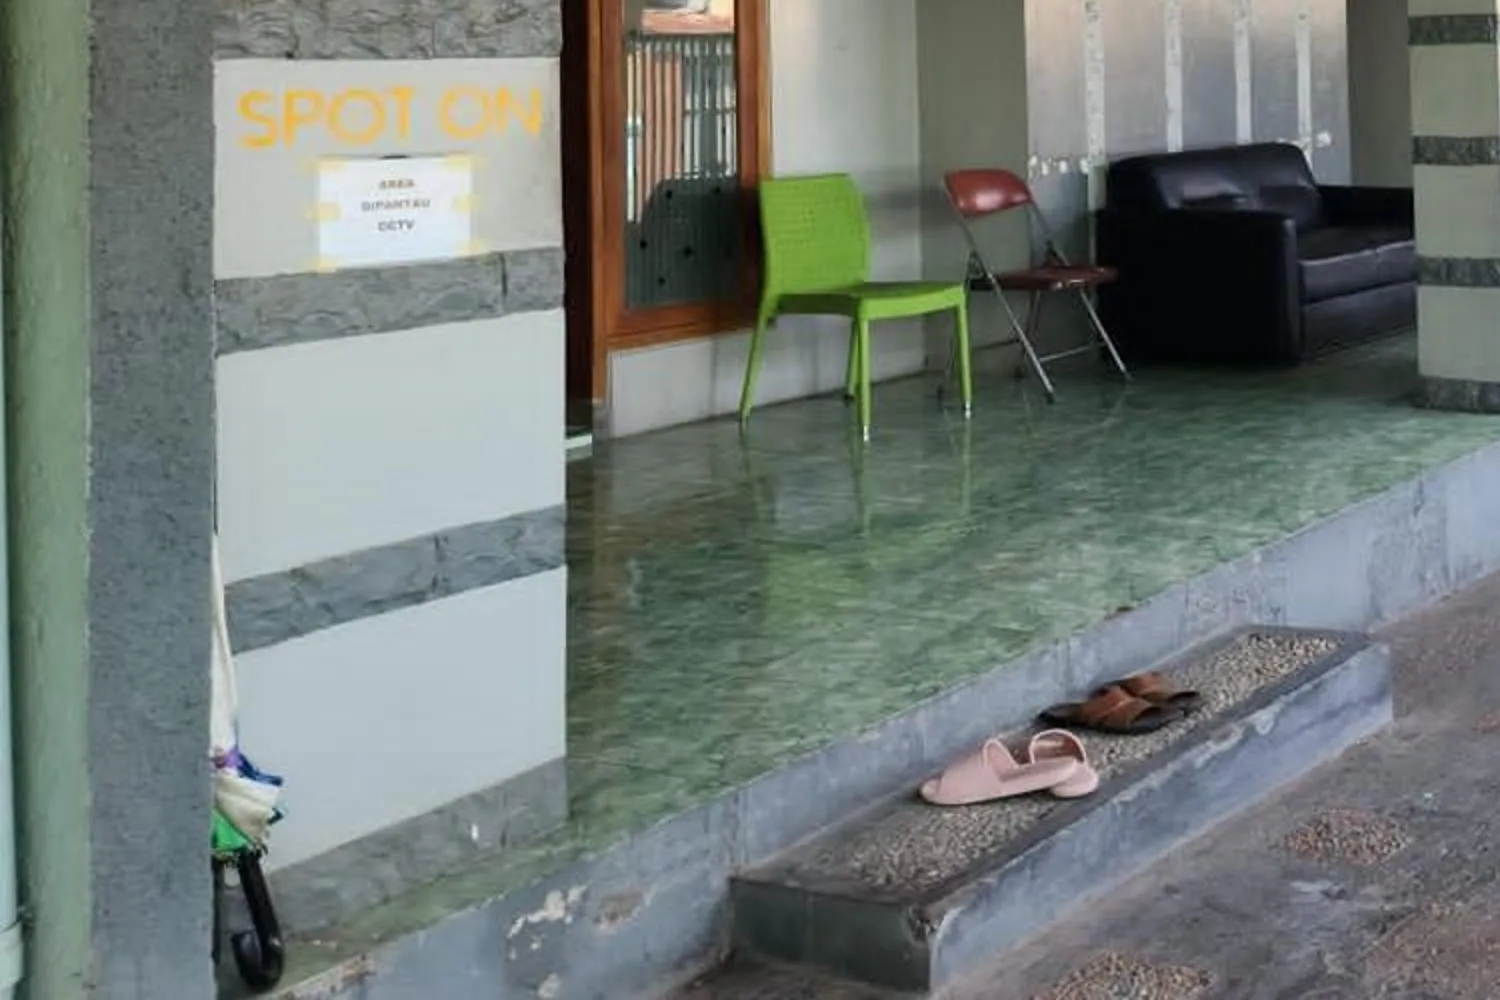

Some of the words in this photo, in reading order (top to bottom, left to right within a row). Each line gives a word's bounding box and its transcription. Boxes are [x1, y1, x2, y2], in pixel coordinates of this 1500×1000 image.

[236, 85, 420, 150] SPOT
[437, 83, 543, 142] ON
[377, 219, 416, 232] CCTV
